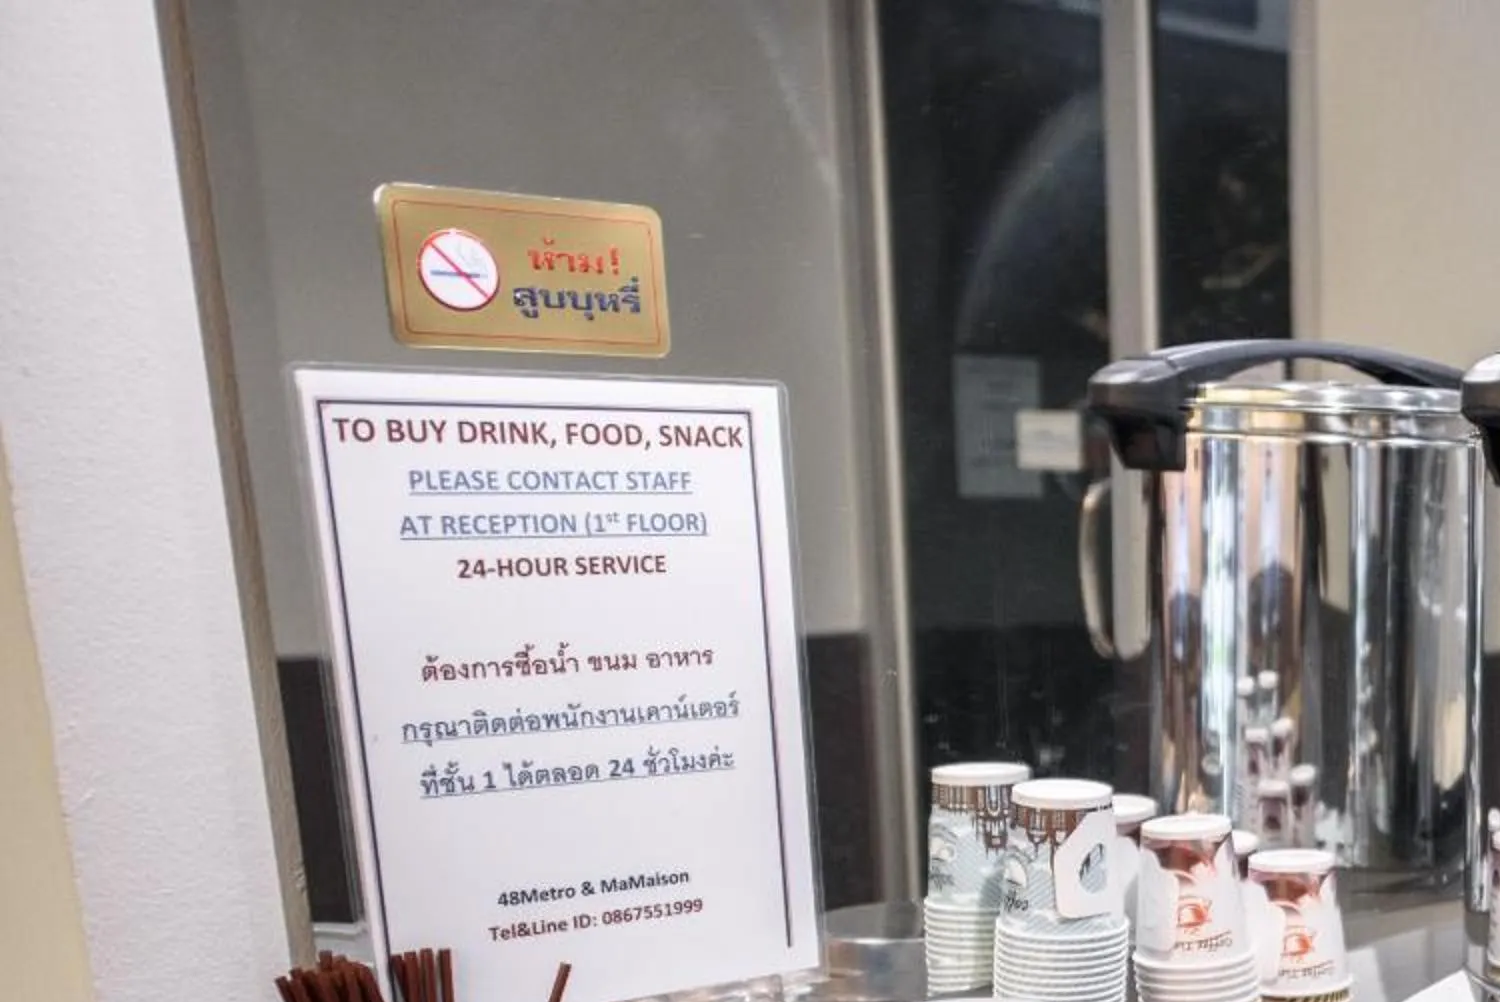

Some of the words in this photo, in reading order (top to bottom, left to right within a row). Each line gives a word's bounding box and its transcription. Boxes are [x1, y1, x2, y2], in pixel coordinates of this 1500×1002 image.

[526, 237, 621, 276] ห้าม!
[513, 276, 641, 321] สูบบุหรี่
[332, 417, 376, 443] TO
[387, 420, 447, 445] BUY
[458, 421, 558, 449] DRINK,
[566, 423, 651, 450] FOOD,
[659, 424, 743, 448] SNACK
[408, 469, 499, 492] PLEASE
[508, 470, 617, 492] CONTACT
[625, 471, 692, 491] STAFF
[400, 516, 433, 537] AT
[441, 514, 577, 536] RECEPTION
[585, 512, 620, 537] (1st
[627, 513, 708, 536] FLOOR)
[457, 558, 568, 579] 24-HOUR
[575, 555, 667, 576] SERVICE
[420, 641, 579, 683] ต้องการซื้อน้ำ
[587, 652, 638, 673] ขนม
[646, 648, 715, 669] อาหาร
[484, 771, 498, 791] 1
[502, 760, 600, 788] ได้ตลอด
[607, 757, 636, 778] 24
[497, 885, 577, 908] 48Metro
[581, 881, 596, 896] &
[601, 870, 690, 894] MaMaison
[488, 918, 568, 942] Tel&Line
[573, 914, 598, 930] ID:
[602, 898, 704, 926] 0867551999
